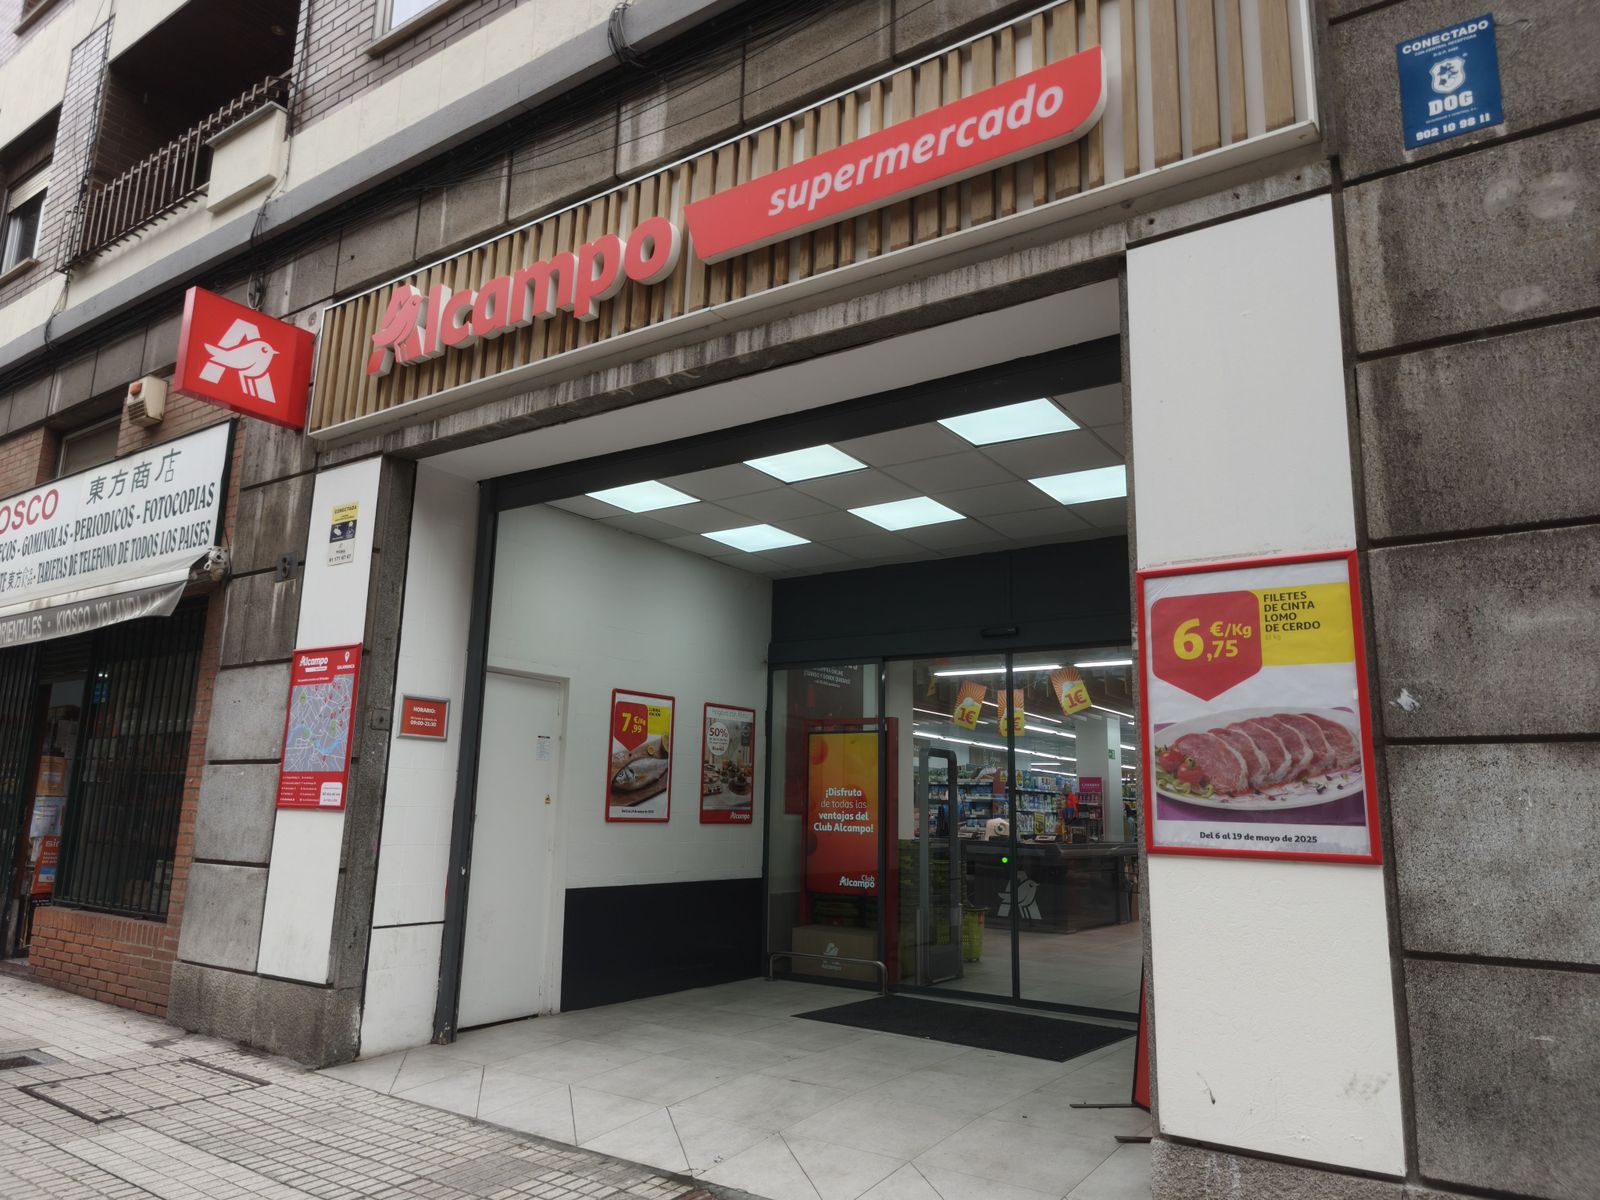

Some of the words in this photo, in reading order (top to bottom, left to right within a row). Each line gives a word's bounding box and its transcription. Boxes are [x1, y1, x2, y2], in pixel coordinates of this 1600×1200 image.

[1402, 20, 1489, 55] CONECTADO
[1428, 90, 1473, 116] DOG
[1416, 127, 1439, 141] 902
[1443, 122, 1456, 134] 10
[1460, 116, 1476, 129] 98
[768, 83, 1064, 217] supermercado
[366, 216, 680, 377] Alcampo
[86, 448, 181, 505] 東方商店
[22, 523, 69, 557] GOMINOLAS
[74, 505, 135, 543] PERIODICOS
[143, 482, 215, 524] FOTOCOPIAS
[68, 554, 78, 577] DE
[79, 543, 116, 575] TELEFONO
[117, 540, 129, 565] DE
[130, 532, 159, 562] TODOS
[159, 528, 178, 555] LOS
[178, 519, 211, 551] PAISES
[1263, 591, 1307, 603] FILETES
[1264, 603, 1278, 612] DE
[1280, 600, 1315, 612] CINTA
[56, 606, 91, 633] KIOSCO
[1265, 612, 1297, 623] LOMO
[1265, 623, 1281, 633] DE
[1282, 620, 1321, 632] CERDO
[1173, 618, 1204, 660] 6
[1209, 621, 1252, 639] €/Kg
[1064, 688, 1089, 709] 1€
[622, 712, 631, 732] 7
[958, 707, 977, 725] 1€
[709, 727, 729, 738] 50%
[825, 787, 862, 798] ¡Disfruta
[821, 799, 830, 808] de
[831, 799, 854, 809] todas
[855, 800, 867, 809] las
[818, 811, 854, 822] ventajas
[855, 811, 869, 820] del
[813, 822, 832, 831] Club
[833, 823, 874, 835] Alcampo!
[1200, 831, 1214, 839] Del
[1215, 832, 1221, 840] 6
[1222, 832, 1231, 840] al
[1232, 832, 1242, 840] 19
[1243, 832, 1255, 841] de
[1256, 835, 1280, 844] mayo
[1281, 834, 1293, 842] de
[1294, 835, 1318, 843] 2025
[839, 876, 875, 888] Alcampo
